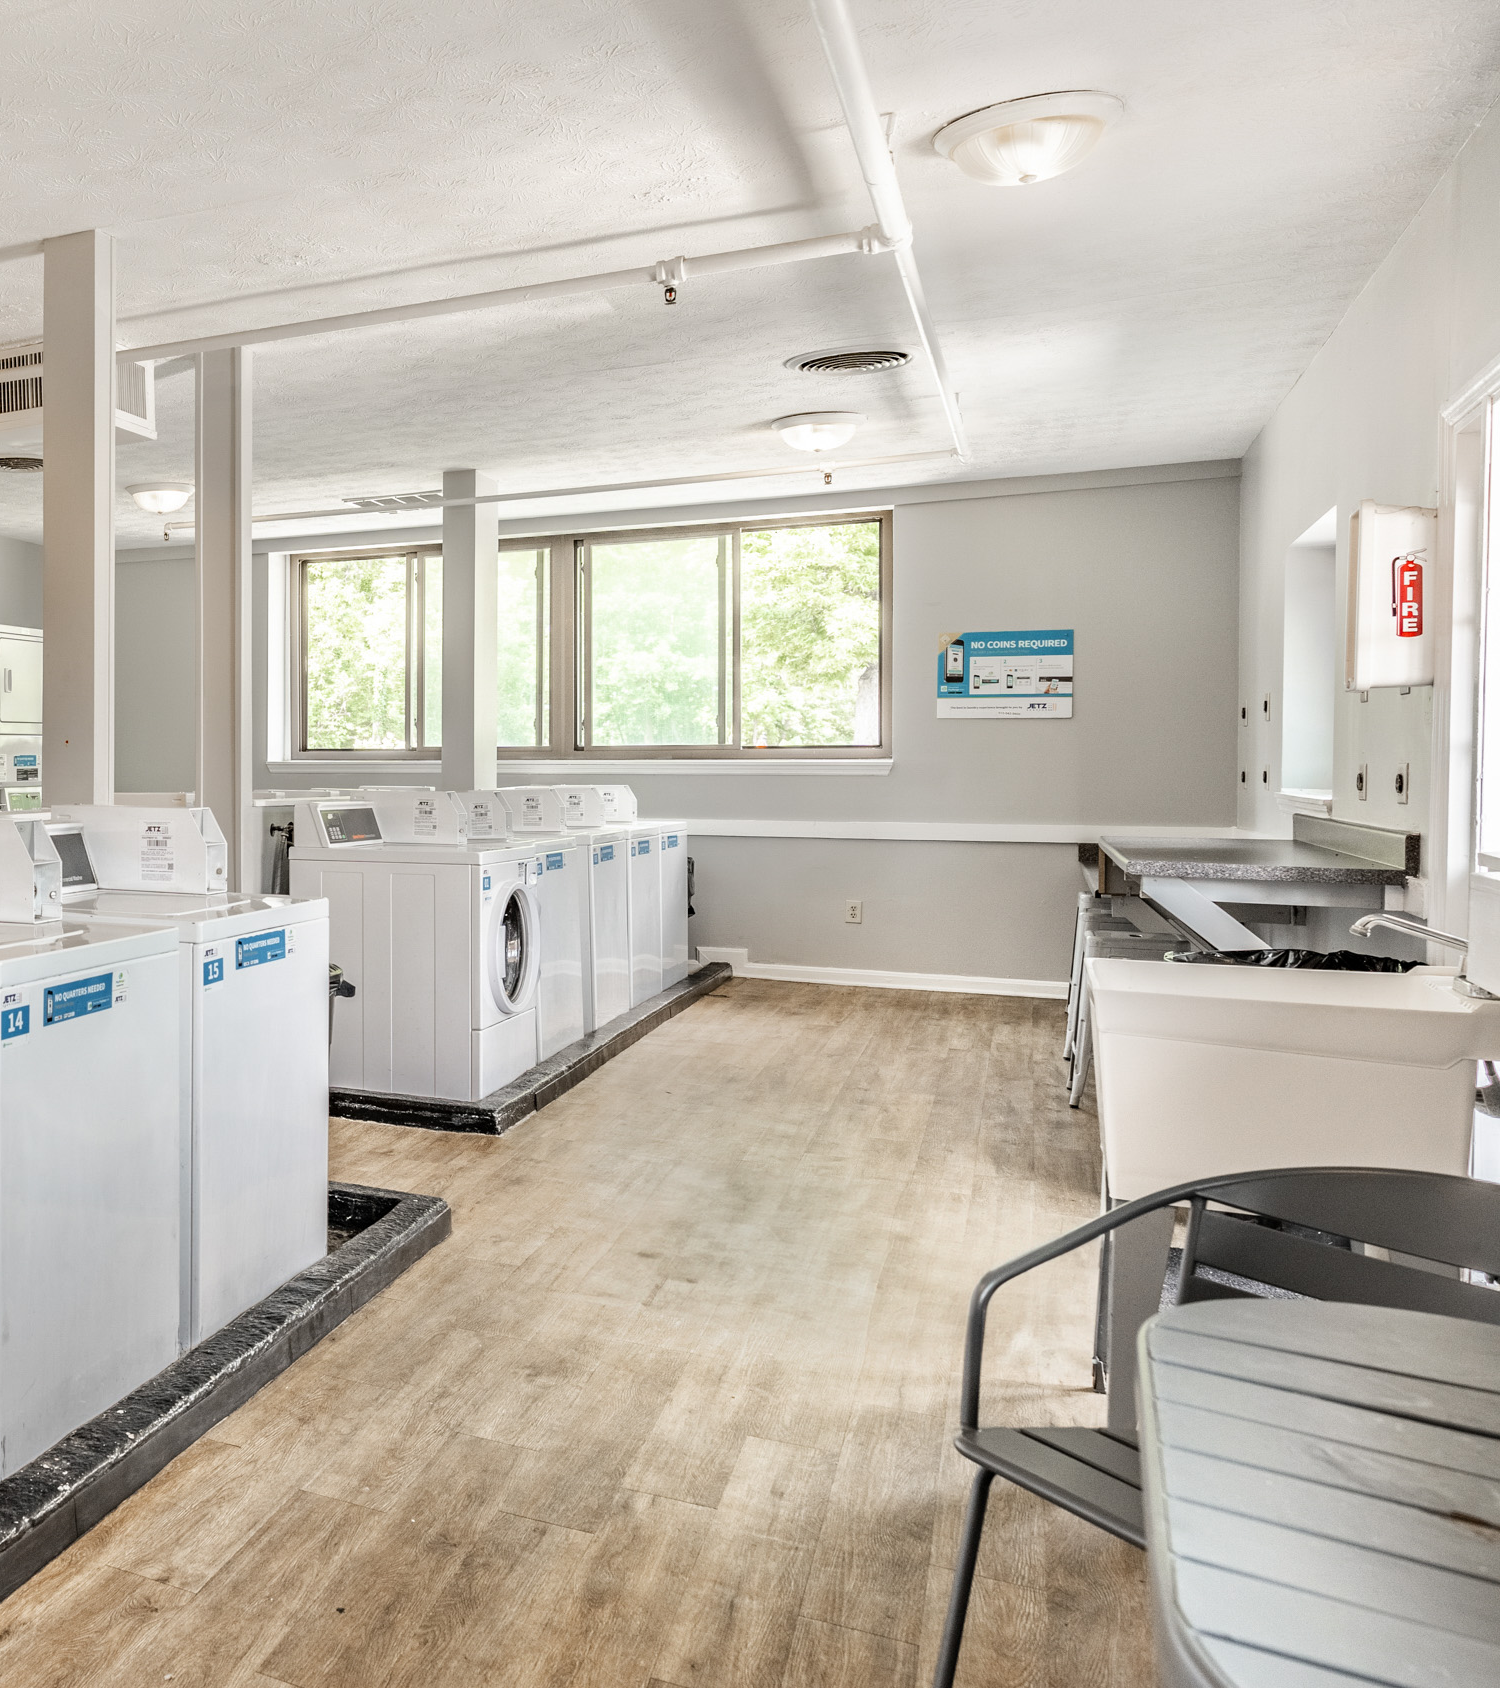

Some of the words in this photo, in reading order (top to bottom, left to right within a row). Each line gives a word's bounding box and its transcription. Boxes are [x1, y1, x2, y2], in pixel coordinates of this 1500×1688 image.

[1402, 571, 1418, 632] FIRE
[970, 641, 986, 649] NO
[987, 641, 1017, 649] COINS
[1018, 639, 1068, 649] REQUIRED
[249, 940, 267, 951] QUARTERS
[267, 937, 280, 945] NEEDED
[208, 962, 219, 980] 15
[3, 994, 16, 1005] JETZ
[55, 994, 62, 1002] NO
[63, 987, 88, 1002] QUARTERS
[88, 983, 106, 994] NEEDED
[8, 1010, 24, 1033] 14
